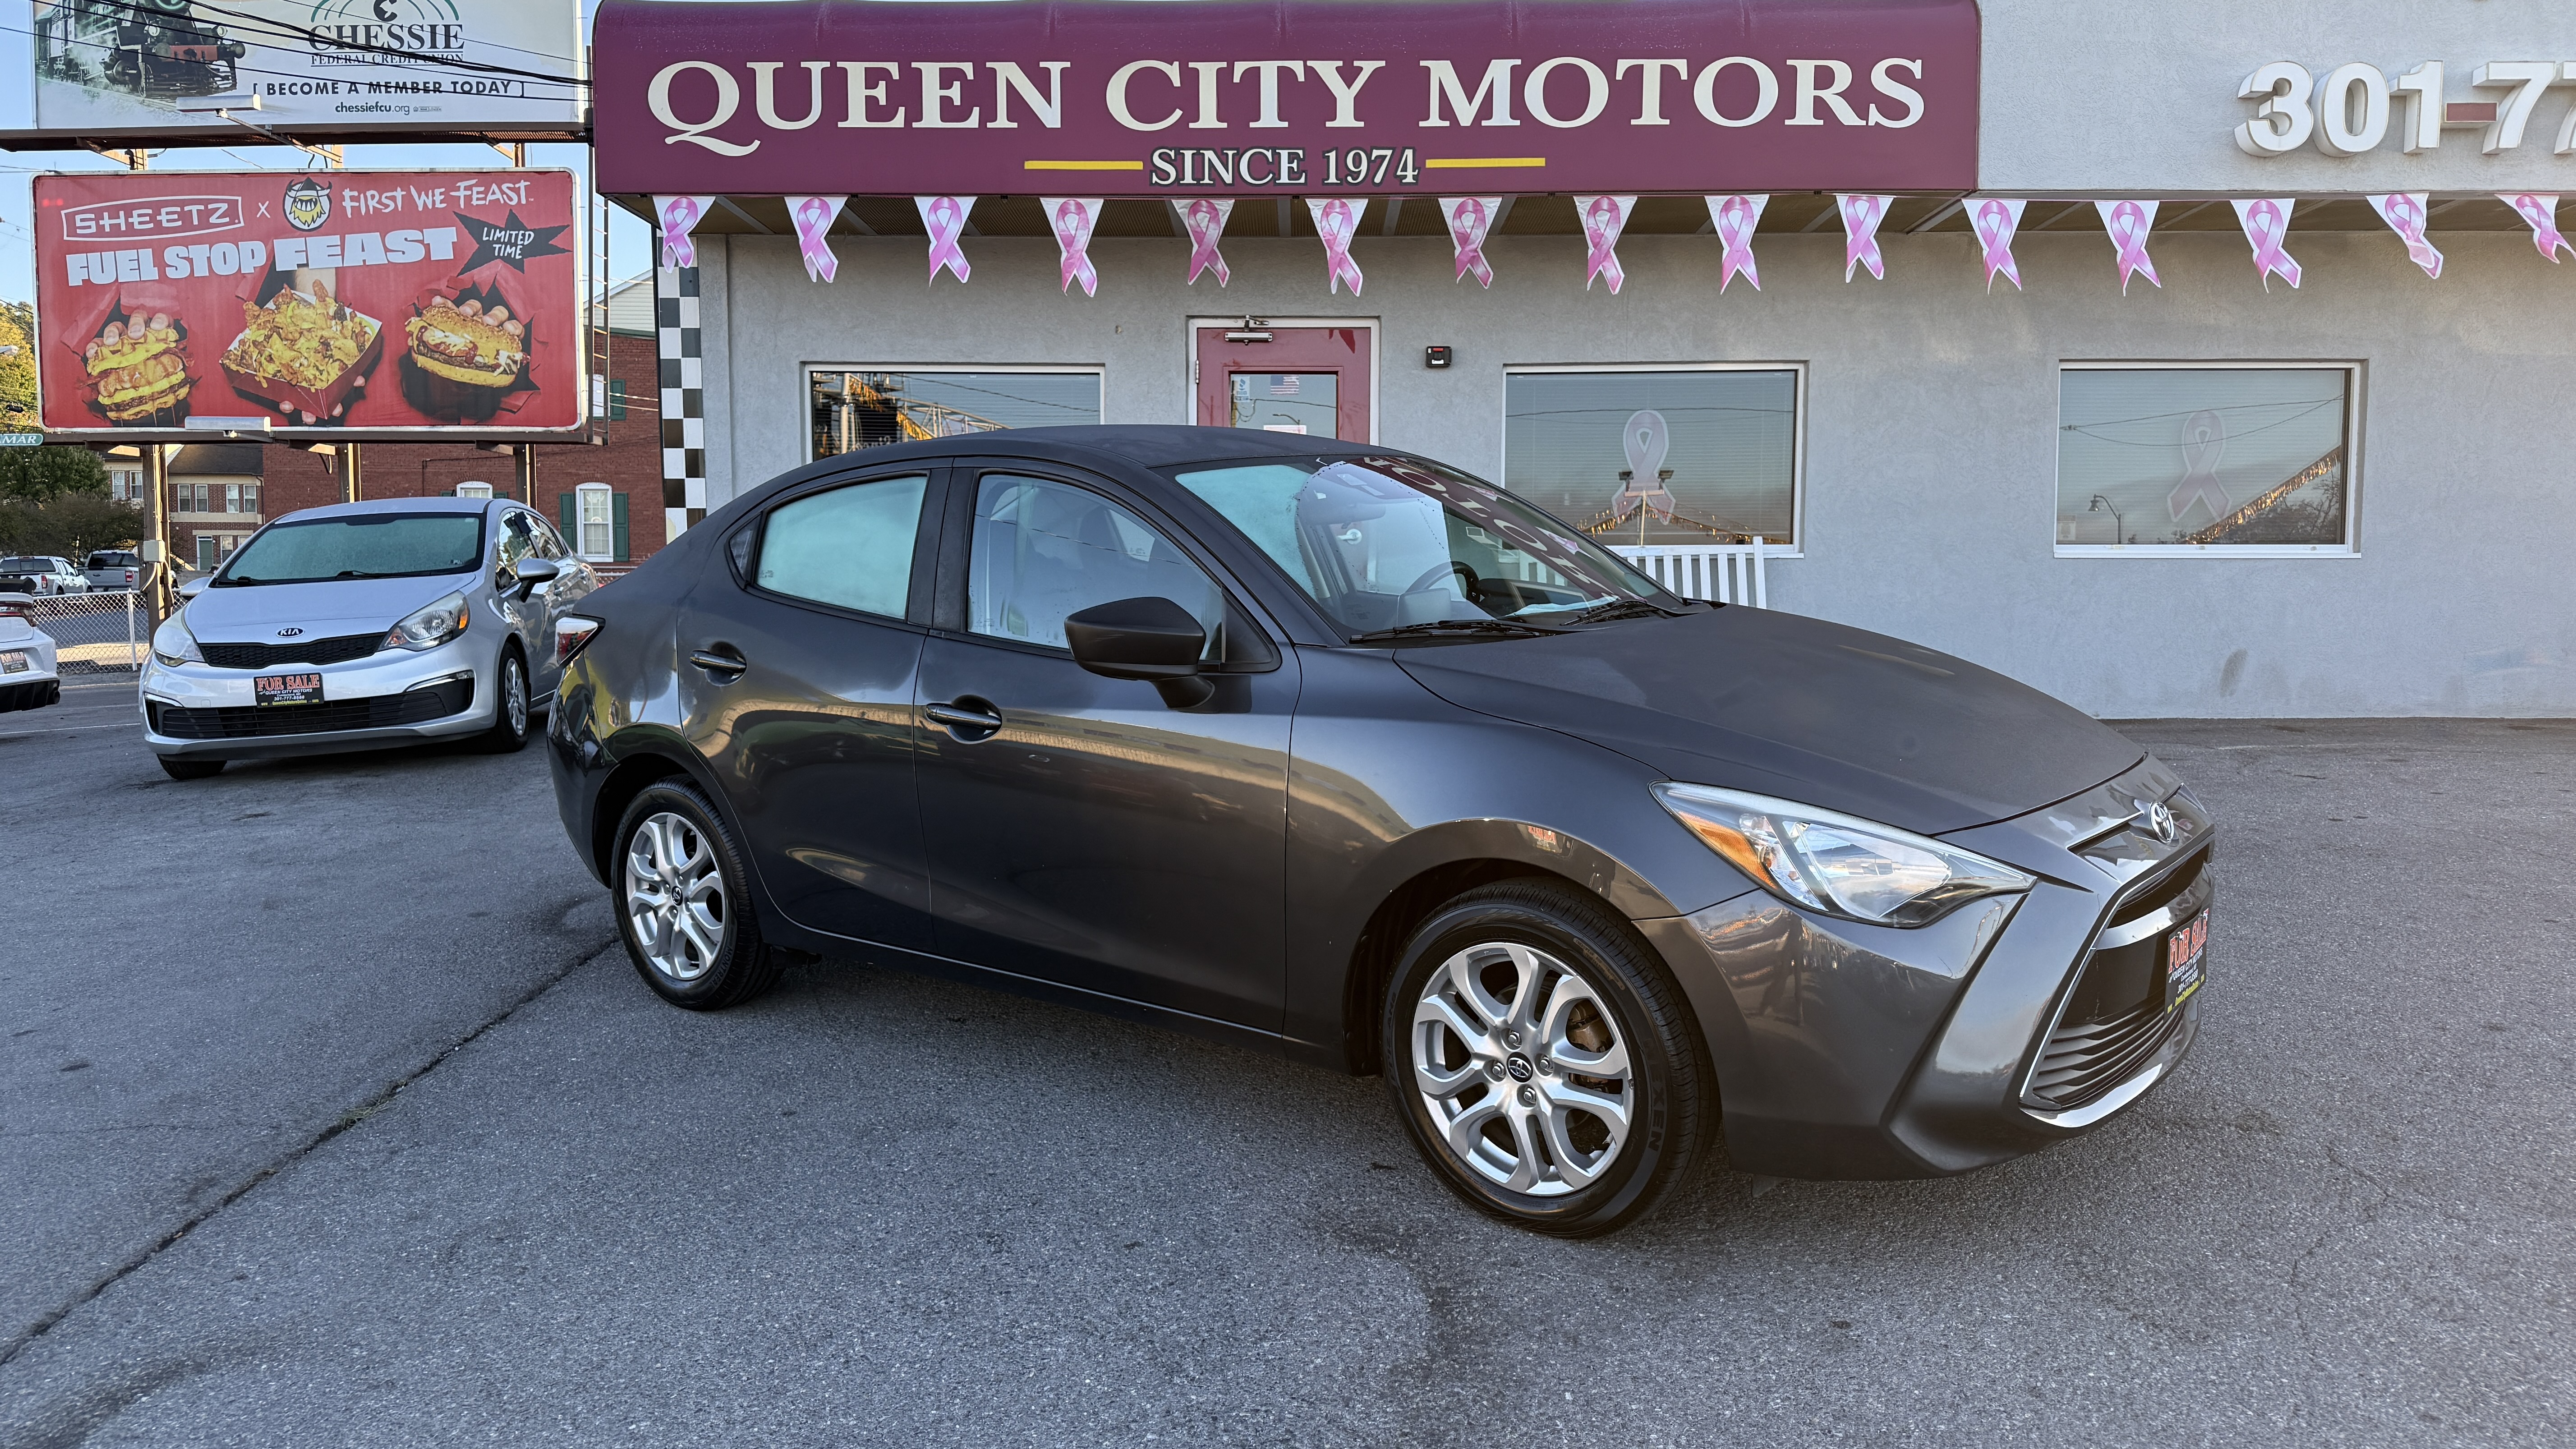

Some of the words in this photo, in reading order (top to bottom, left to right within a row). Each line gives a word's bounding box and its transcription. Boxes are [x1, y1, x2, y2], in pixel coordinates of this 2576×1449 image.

[308, 24, 465, 51] CHESSIE
[311, 54, 370, 64] FEDERAL
[267, 82, 339, 95] BECOME
[347, 82, 359, 94] A
[368, 81, 442, 94] MEMBER
[451, 81, 512, 94] TODAY
[335, 101, 409, 115] chessiefcu.org
[647, 60, 1072, 157] QUEEN
[1105, 59, 1386, 131] CITY
[1418, 56, 1925, 129] MOTORS
[2235, 60, 2576, 157] 301-7
[1151, 147, 1306, 185] SINCE
[1323, 148, 1417, 185] 1974
[75, 203, 230, 234] SHEETZ
[342, 186, 406, 218] FIRST
[410, 185, 447, 211] WE
[450, 179, 531, 209] FEAST
[482, 227, 534, 245] LIMITED
[492, 244, 523, 259] TIME
[66, 248, 159, 286] FUEL
[164, 240, 267, 279] STOP
[273, 227, 457, 271] FEAST
[256, 677, 284, 691] FOR
[286, 675, 320, 690] SALE
[2168, 927, 2190, 974] FOR
[2190, 908, 2209, 957] SALE
[709, 945, 733, 988] MONTREAL
